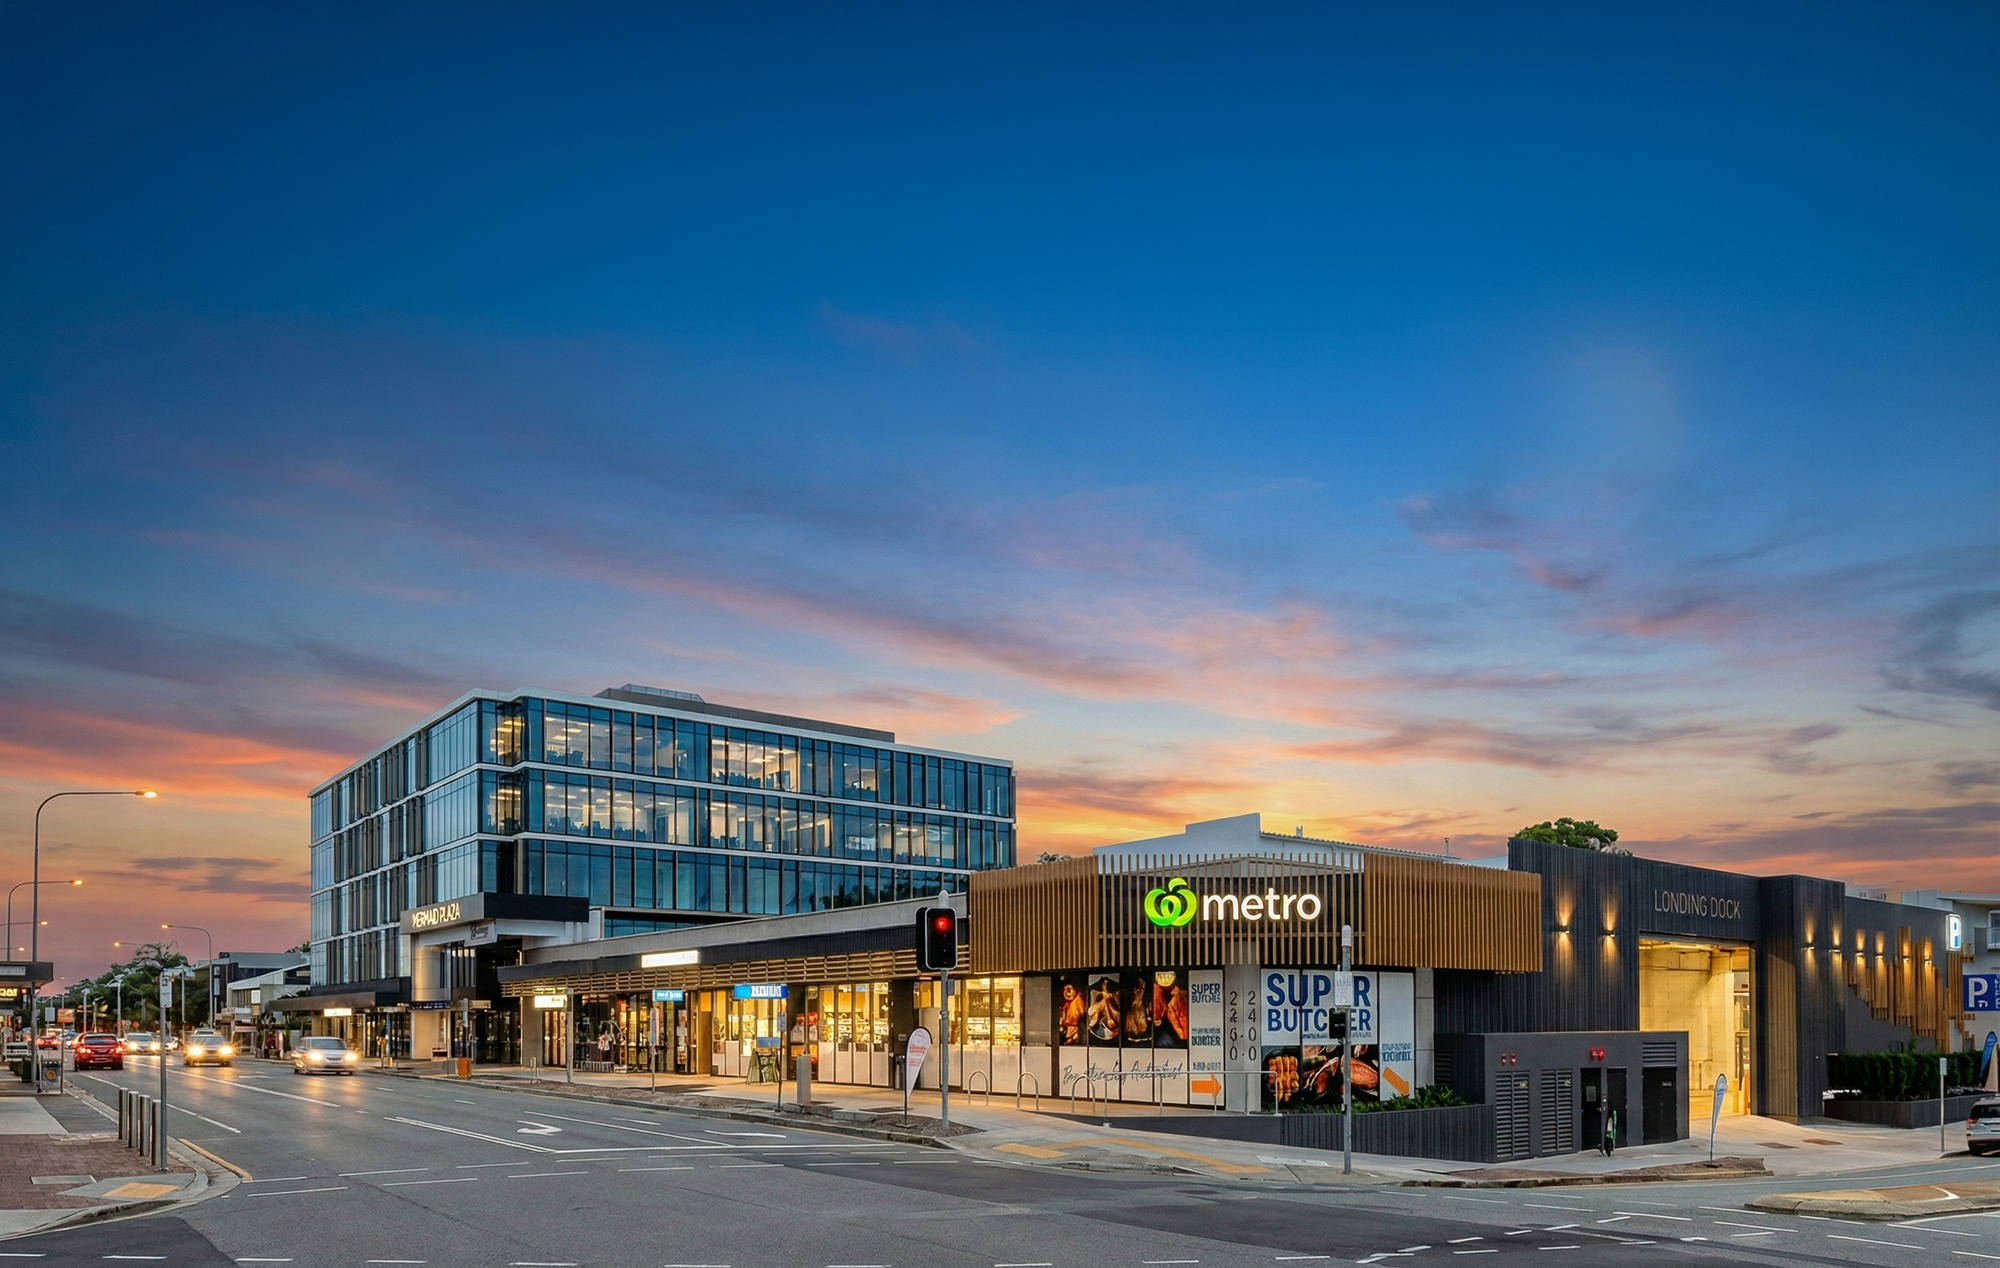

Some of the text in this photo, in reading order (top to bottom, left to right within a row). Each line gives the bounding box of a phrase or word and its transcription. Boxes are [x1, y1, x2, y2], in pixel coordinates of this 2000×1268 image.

[1203, 887, 1321, 921] metro
[1710, 896, 1741, 920] DOCK
[1191, 983, 1220, 995] SUPER
[1266, 972, 1372, 1007] SUPR
[1968, 977, 1988, 1008] P
[1267, 1008, 1372, 1032] BUTCER
